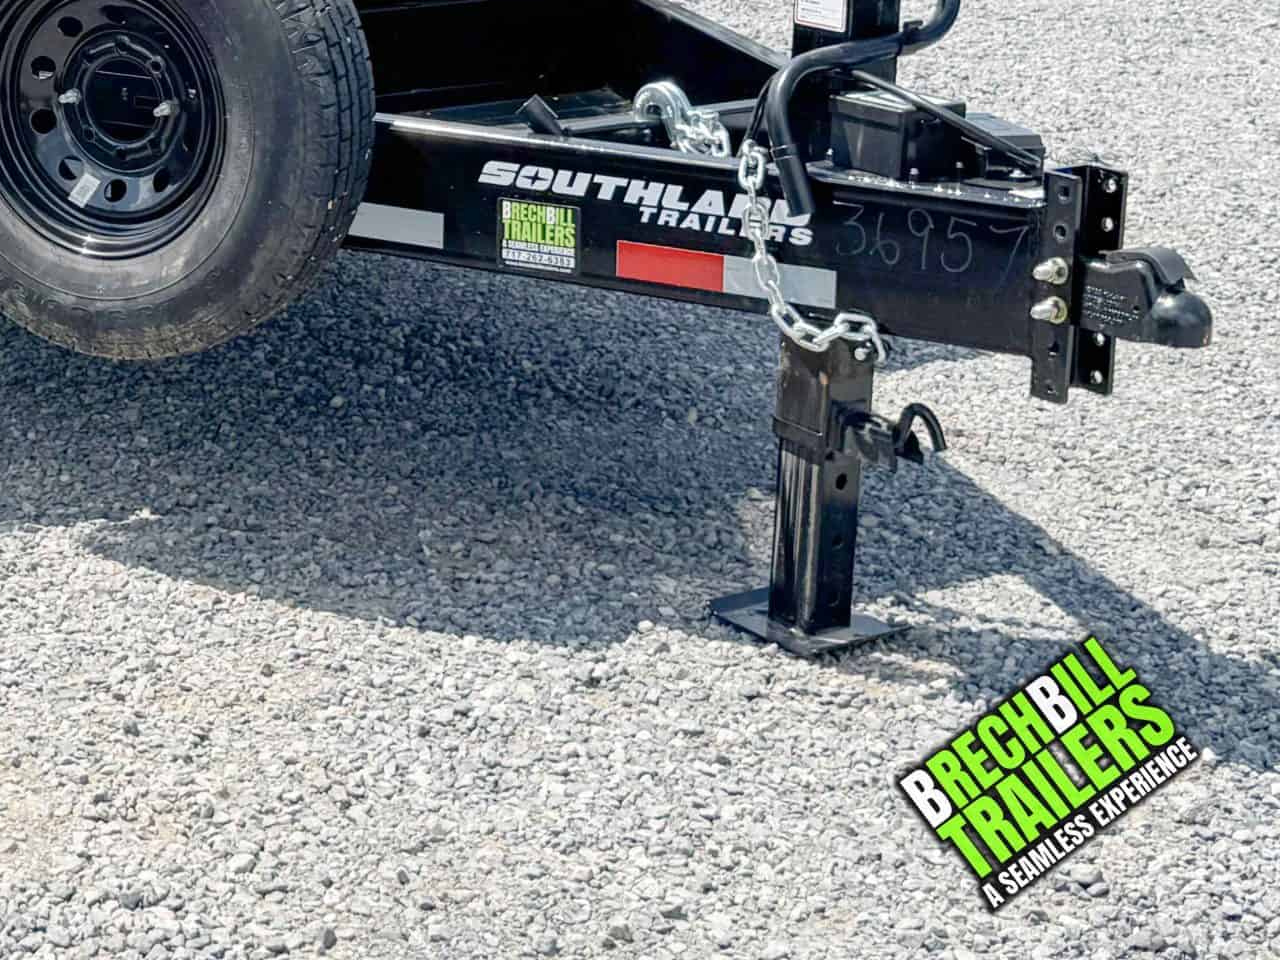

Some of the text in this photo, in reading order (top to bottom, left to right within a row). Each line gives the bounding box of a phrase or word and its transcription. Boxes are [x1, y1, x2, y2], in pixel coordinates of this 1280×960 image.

[502, 200, 576, 228] BRECHBILL
[502, 219, 576, 249] TRAILERS
[832, 199, 1030, 284] 36957
